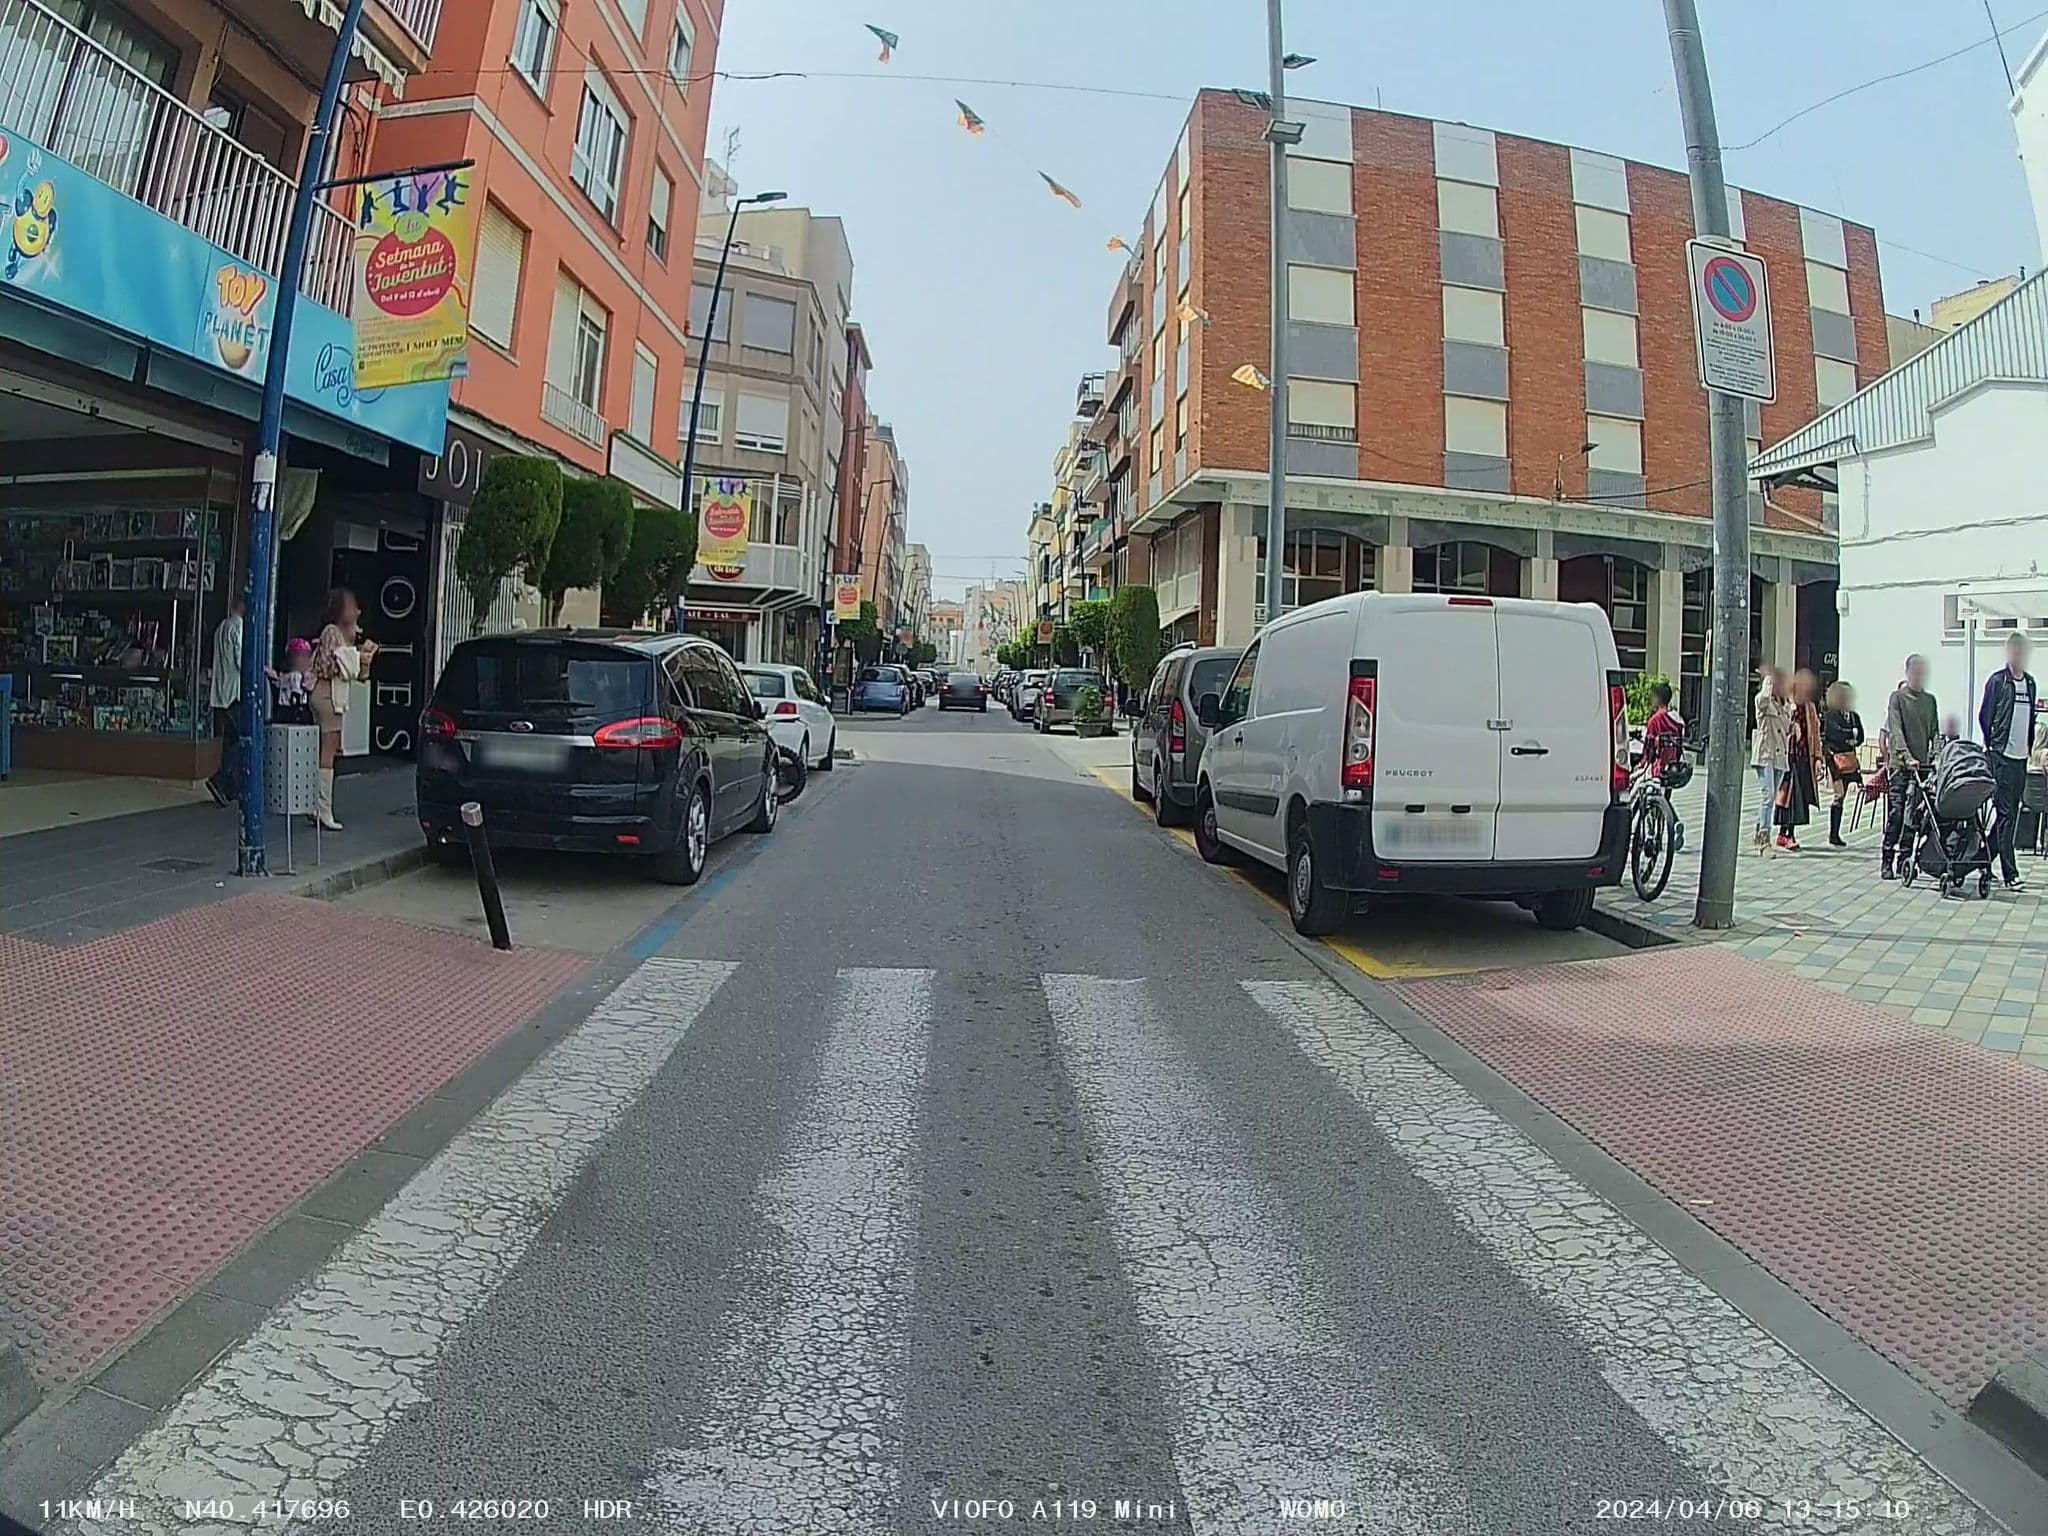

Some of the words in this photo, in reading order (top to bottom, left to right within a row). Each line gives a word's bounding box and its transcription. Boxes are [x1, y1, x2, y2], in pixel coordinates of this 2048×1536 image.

[372, 256, 448, 292] Joventut
[375, 241, 445, 269] Setmana
[217, 263, 266, 316] TOY
[203, 312, 270, 352] PLANET
[315, 343, 347, 392] Casa
[376, 530, 417, 750] JOIES
